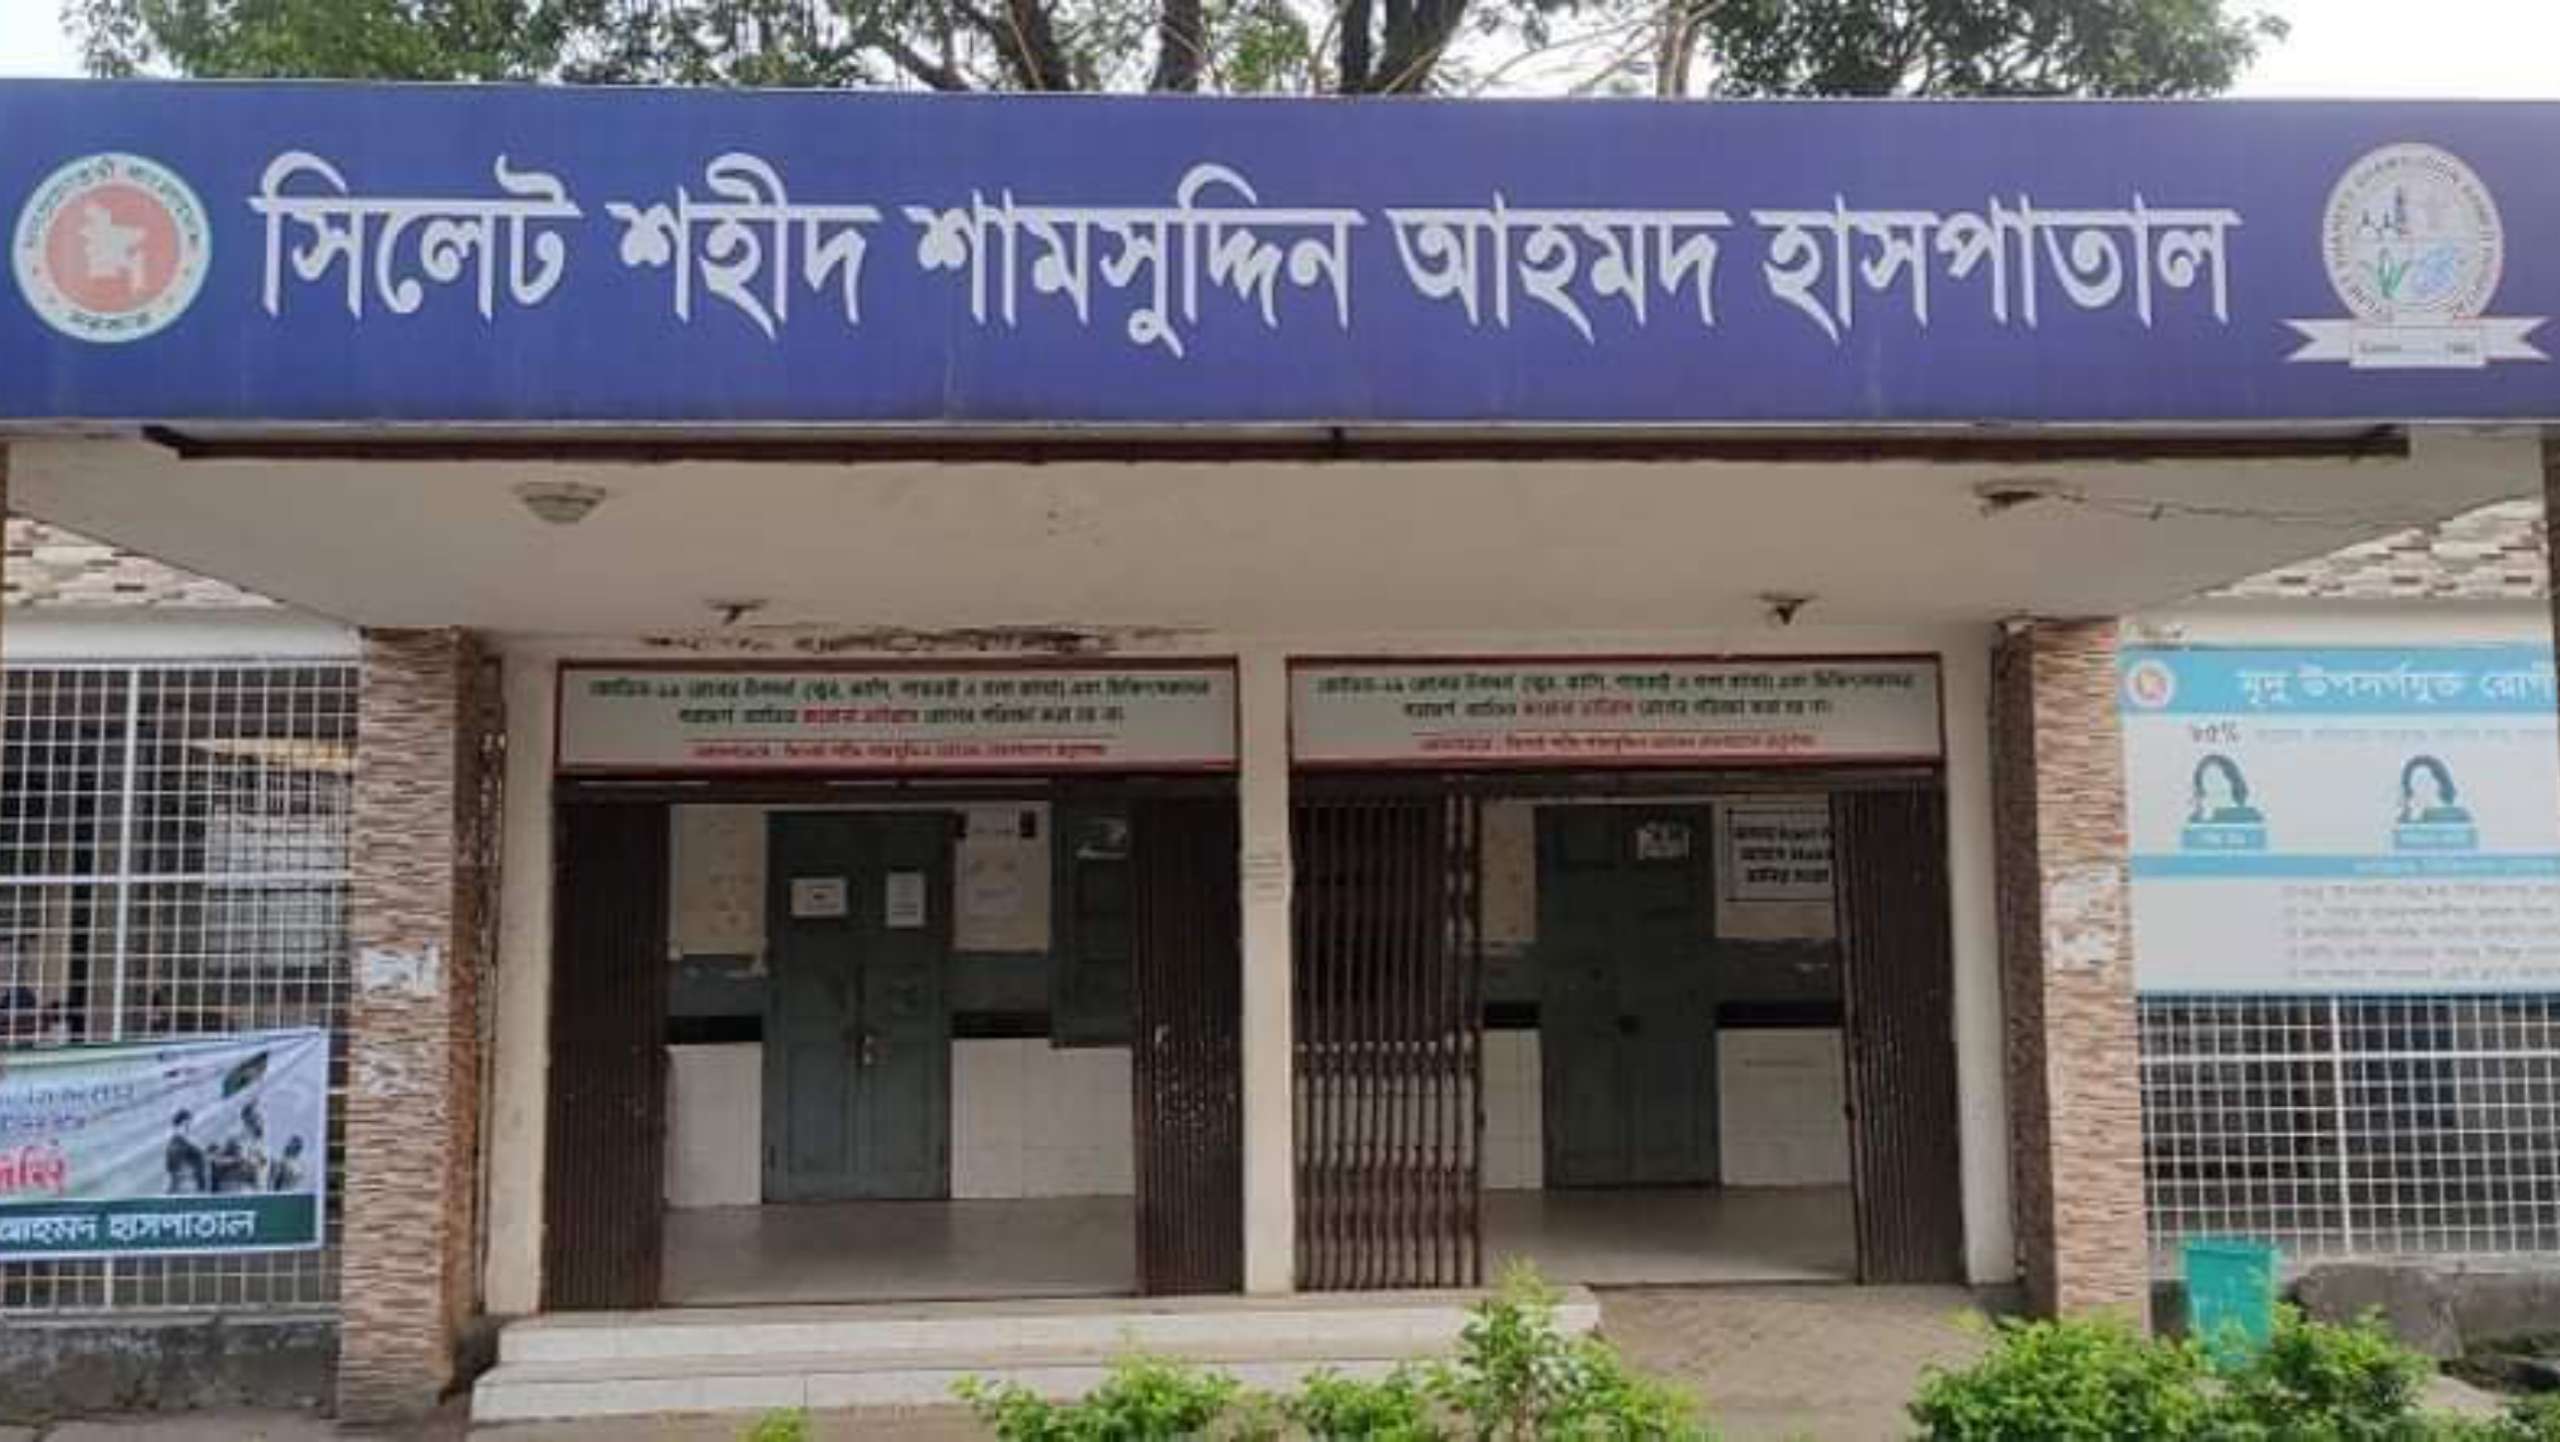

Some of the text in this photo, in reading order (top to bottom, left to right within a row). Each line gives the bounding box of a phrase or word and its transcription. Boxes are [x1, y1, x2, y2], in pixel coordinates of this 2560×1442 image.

[248, 151, 582, 320] সিলেট
[605, 152, 881, 338] শহীদ
[903, 164, 1366, 357] শামসুদ্দিন
[1385, 193, 1732, 340] আহমদ
[1750, 193, 2242, 340] হাসপাতাল
[108, 1209, 257, 1242] হাসপাতাল
